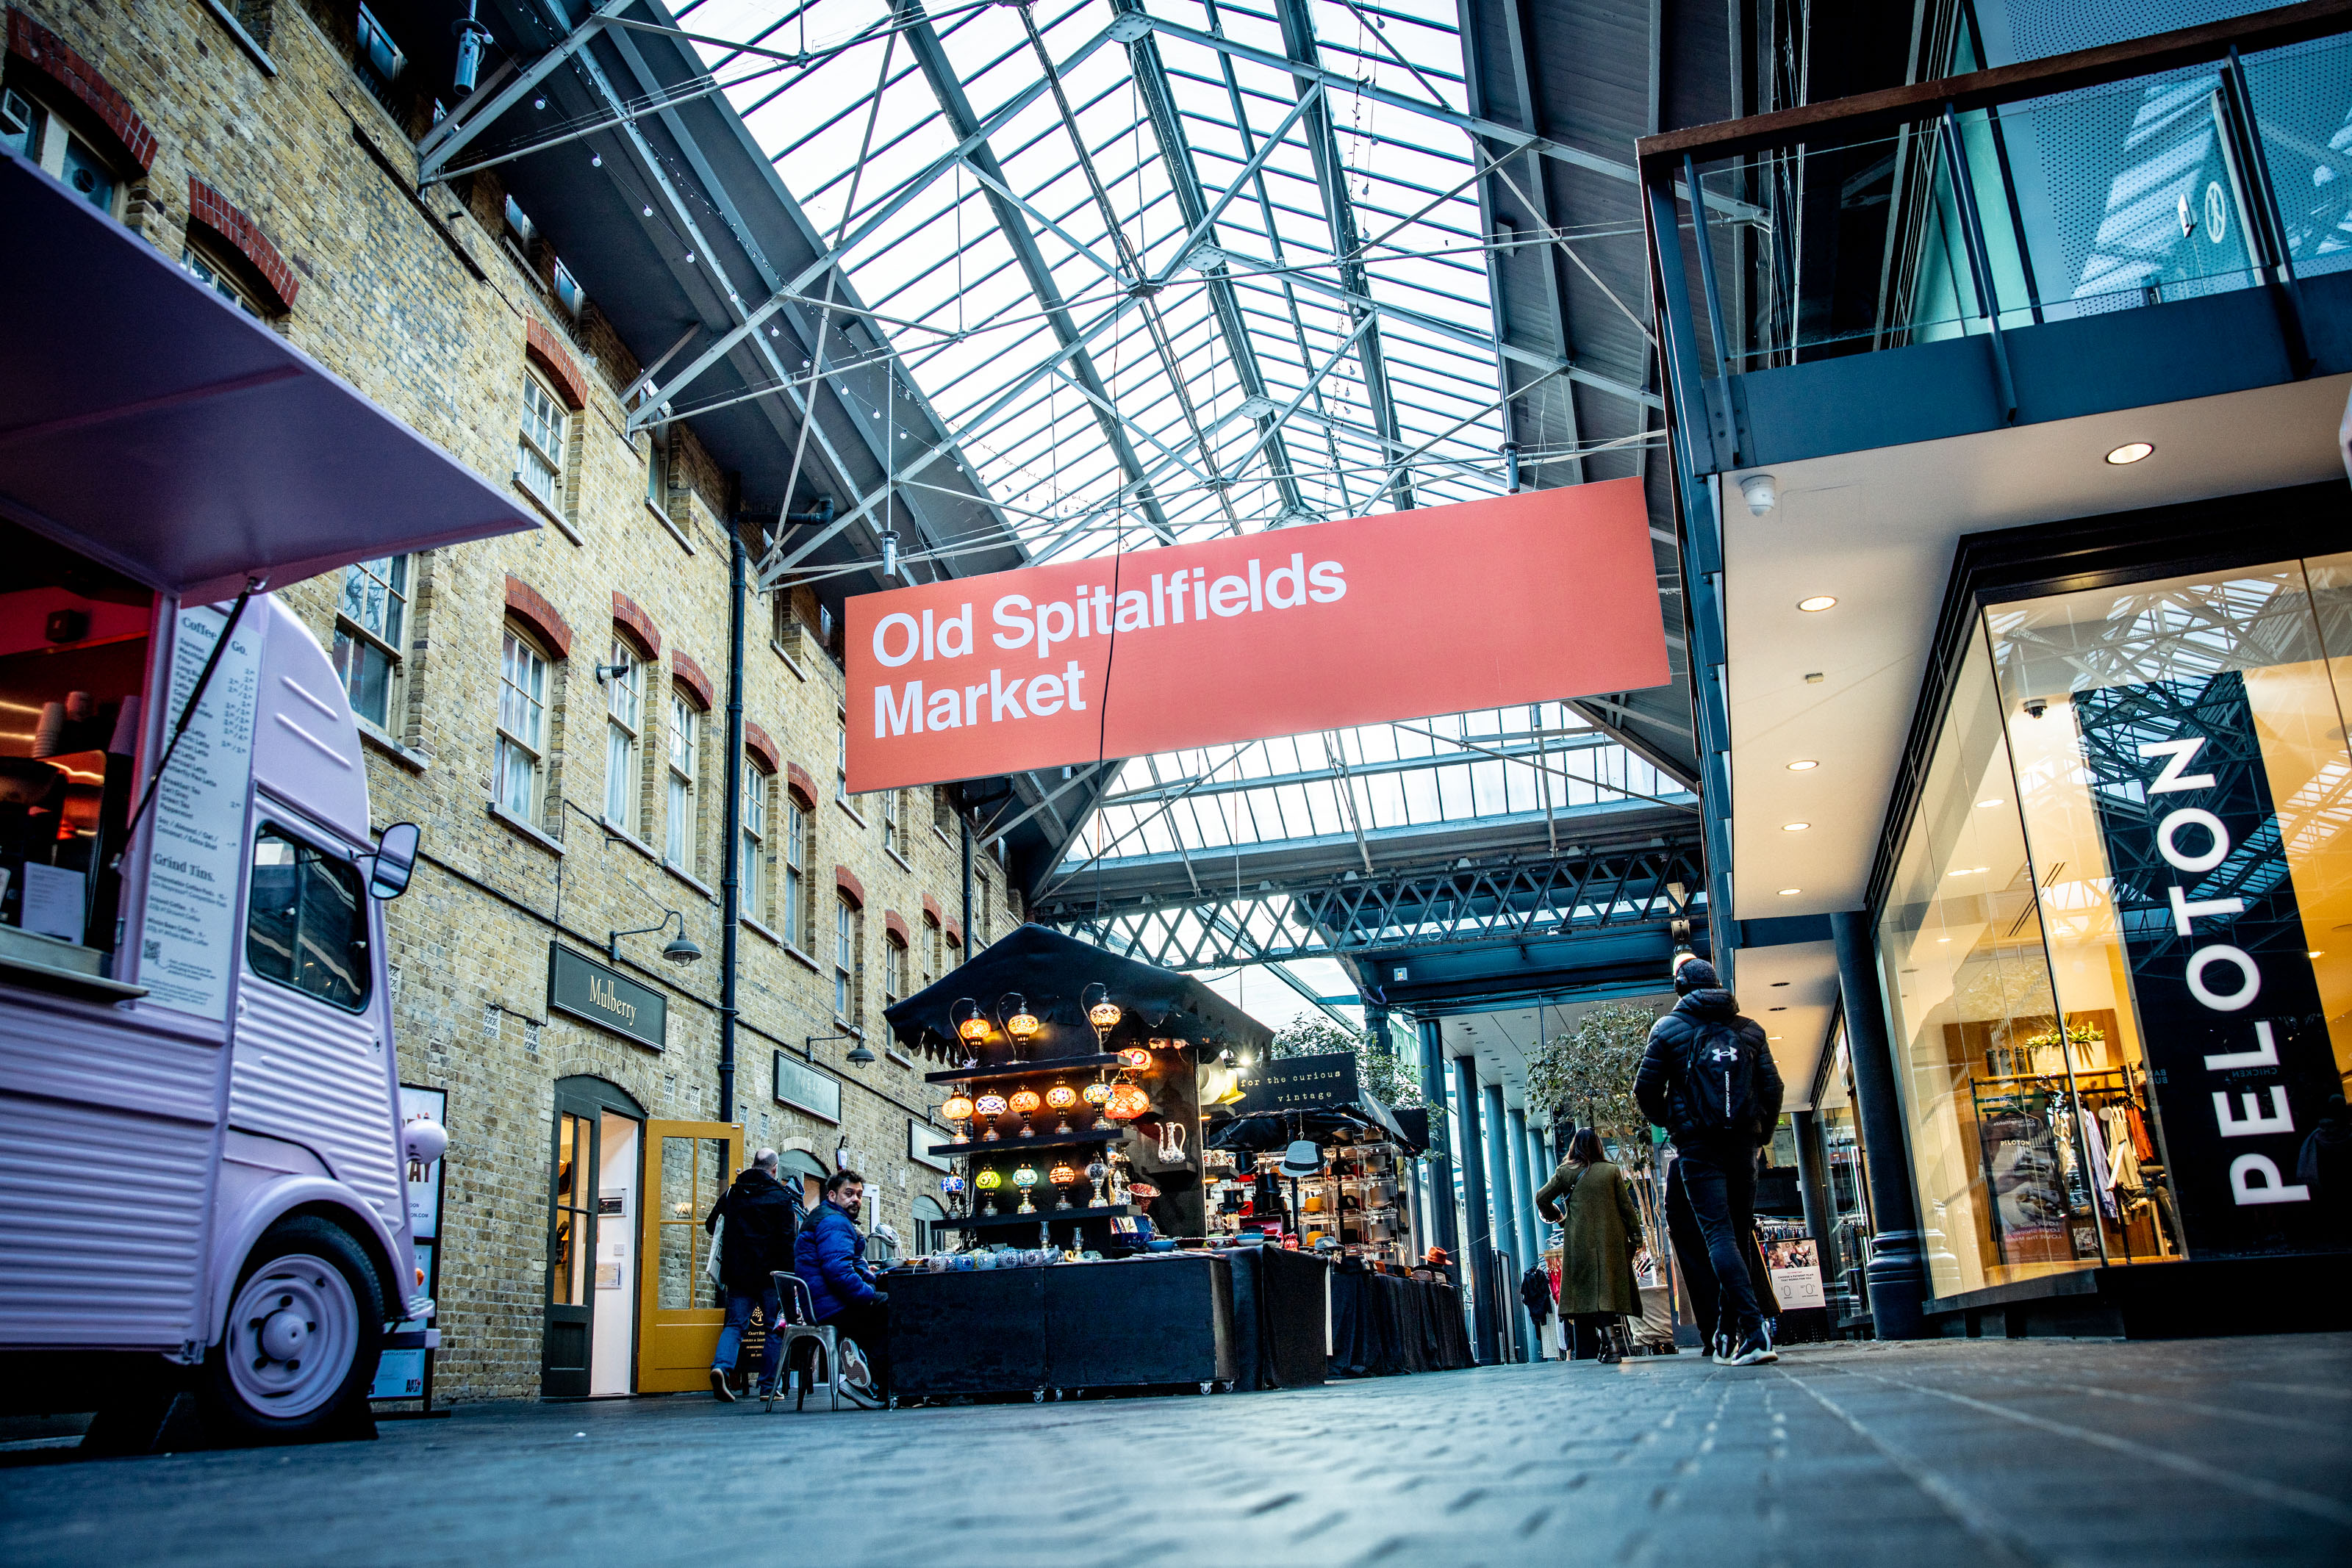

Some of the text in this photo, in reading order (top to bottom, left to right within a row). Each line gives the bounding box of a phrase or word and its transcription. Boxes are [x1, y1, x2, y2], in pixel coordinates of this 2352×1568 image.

[183, 616, 217, 640] Coffee
[872, 553, 1347, 667] Old Spitalfields
[875, 661, 1086, 738] Market
[154, 853, 215, 882] Grind Tins.
[2138, 737, 2311, 1206] PELOTON
[589, 975, 637, 1026] Mulberry
[1241, 1079, 1260, 1087] for
[1293, 1071, 1341, 1082] curious
[1277, 1091, 1332, 1102] vintage
